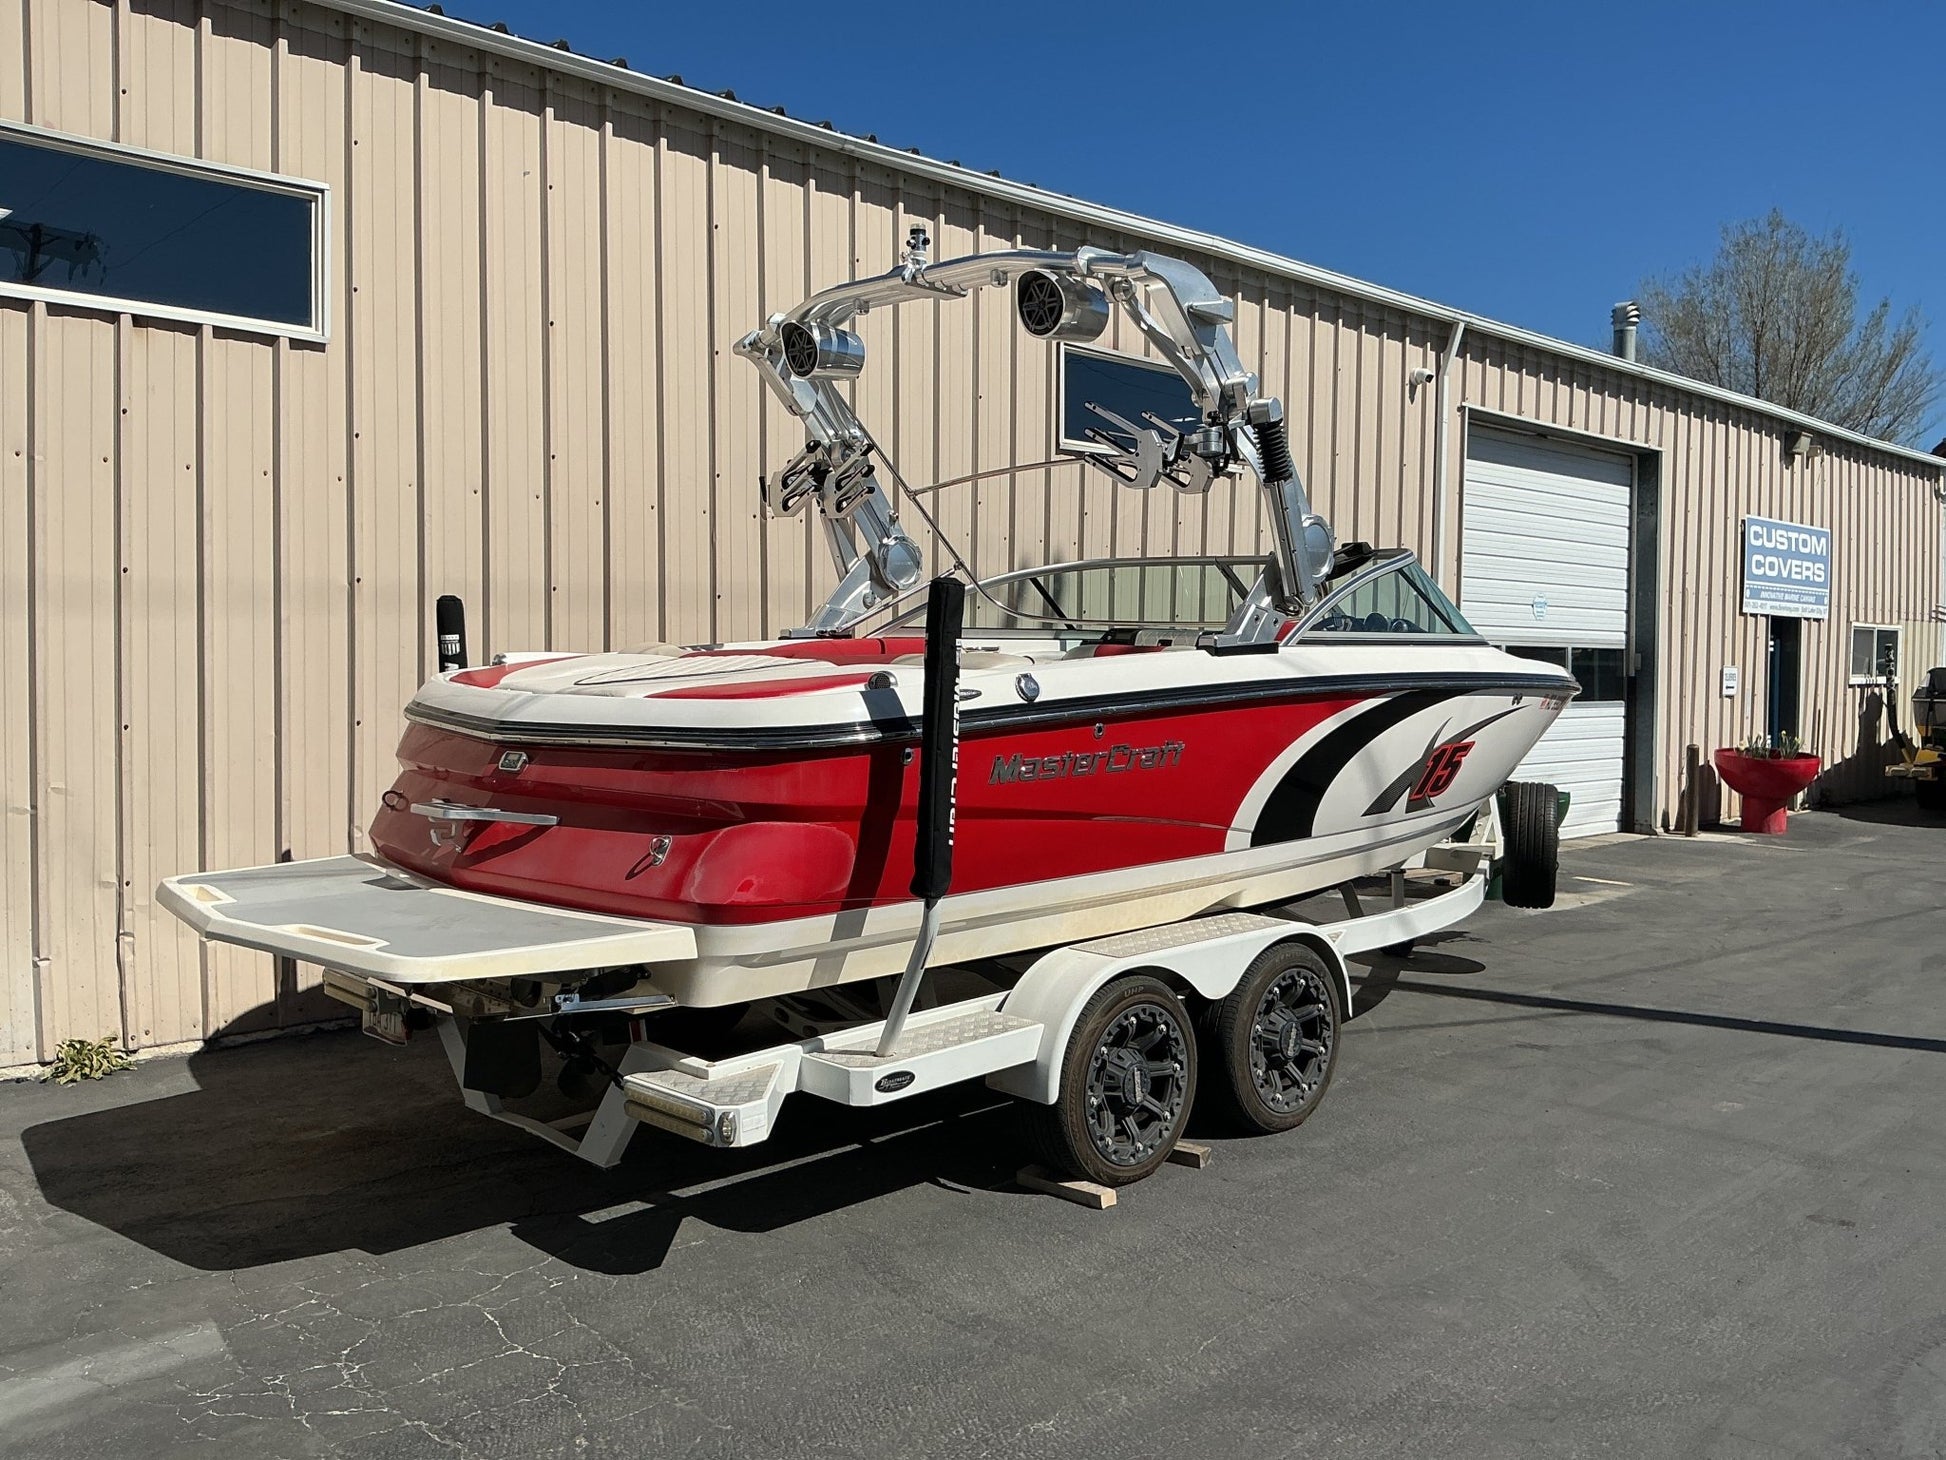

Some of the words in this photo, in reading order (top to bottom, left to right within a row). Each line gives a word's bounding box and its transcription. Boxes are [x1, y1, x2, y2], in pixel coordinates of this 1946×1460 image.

[1749, 524, 1827, 557] CUSTOM
[1751, 554, 1825, 582] COVERS
[988, 739, 1186, 786] MasterCraft
[1124, 985, 1145, 998] UHP
